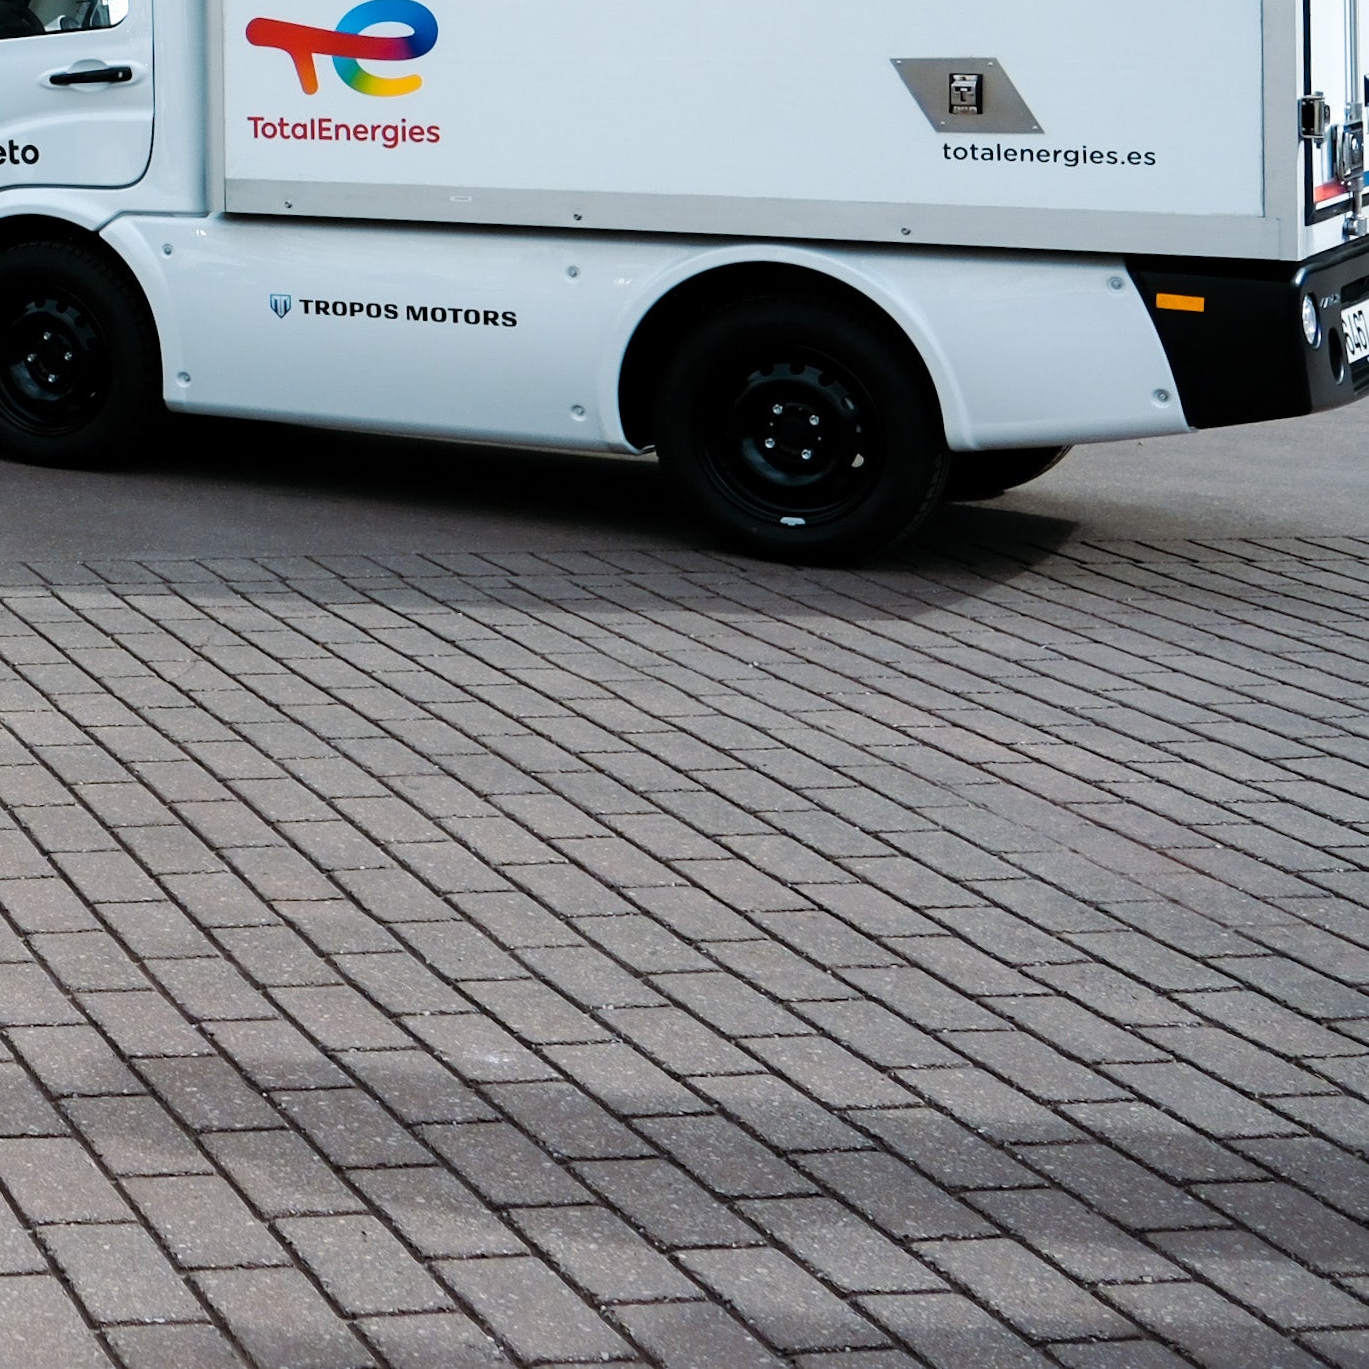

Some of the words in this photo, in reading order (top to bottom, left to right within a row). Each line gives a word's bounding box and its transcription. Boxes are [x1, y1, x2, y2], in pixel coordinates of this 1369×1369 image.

[247, 116, 441, 149] TotalEnergies
[942, 142, 1157, 167] totalenergies.es
[299, 298, 399, 320] TROPOS
[406, 305, 518, 327] MOTORS
